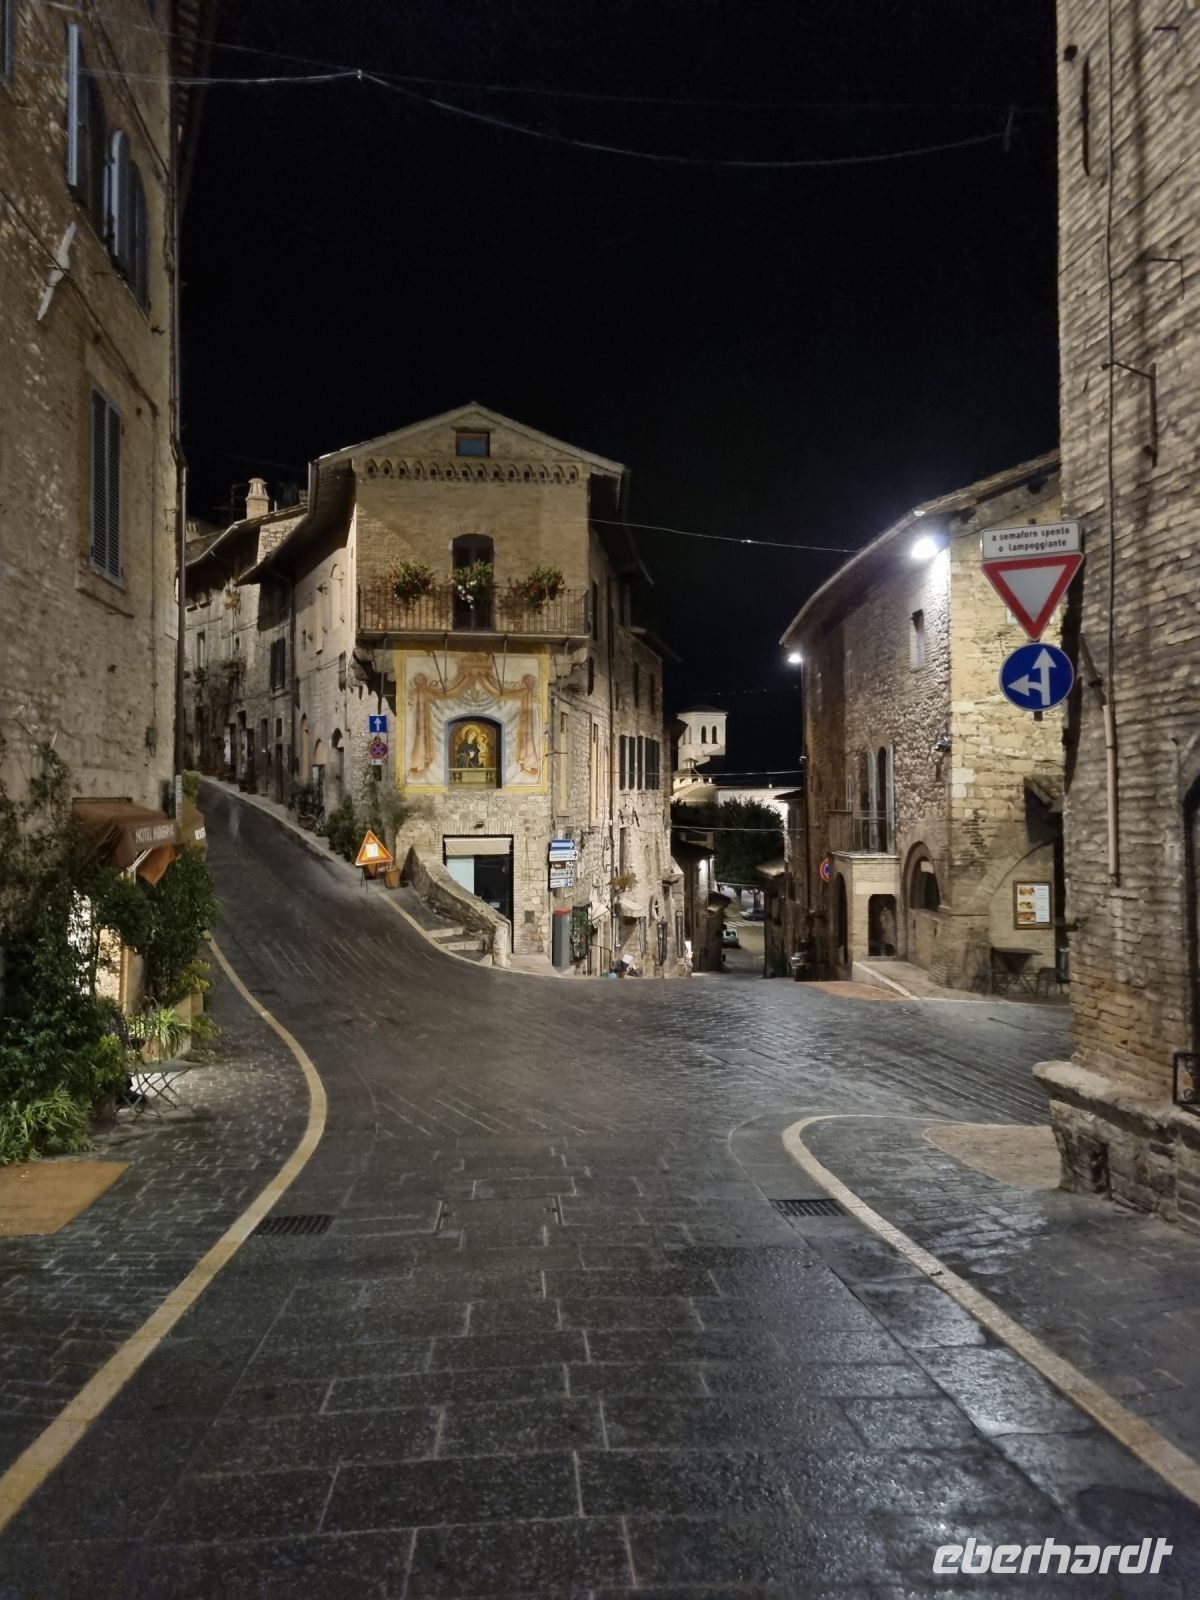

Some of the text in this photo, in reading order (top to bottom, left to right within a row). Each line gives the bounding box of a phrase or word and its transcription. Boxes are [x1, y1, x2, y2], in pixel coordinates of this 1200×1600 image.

[999, 530, 1038, 541] semaforo
[1041, 527, 1070, 537] spento
[1008, 540, 1067, 551] lampeggiante
